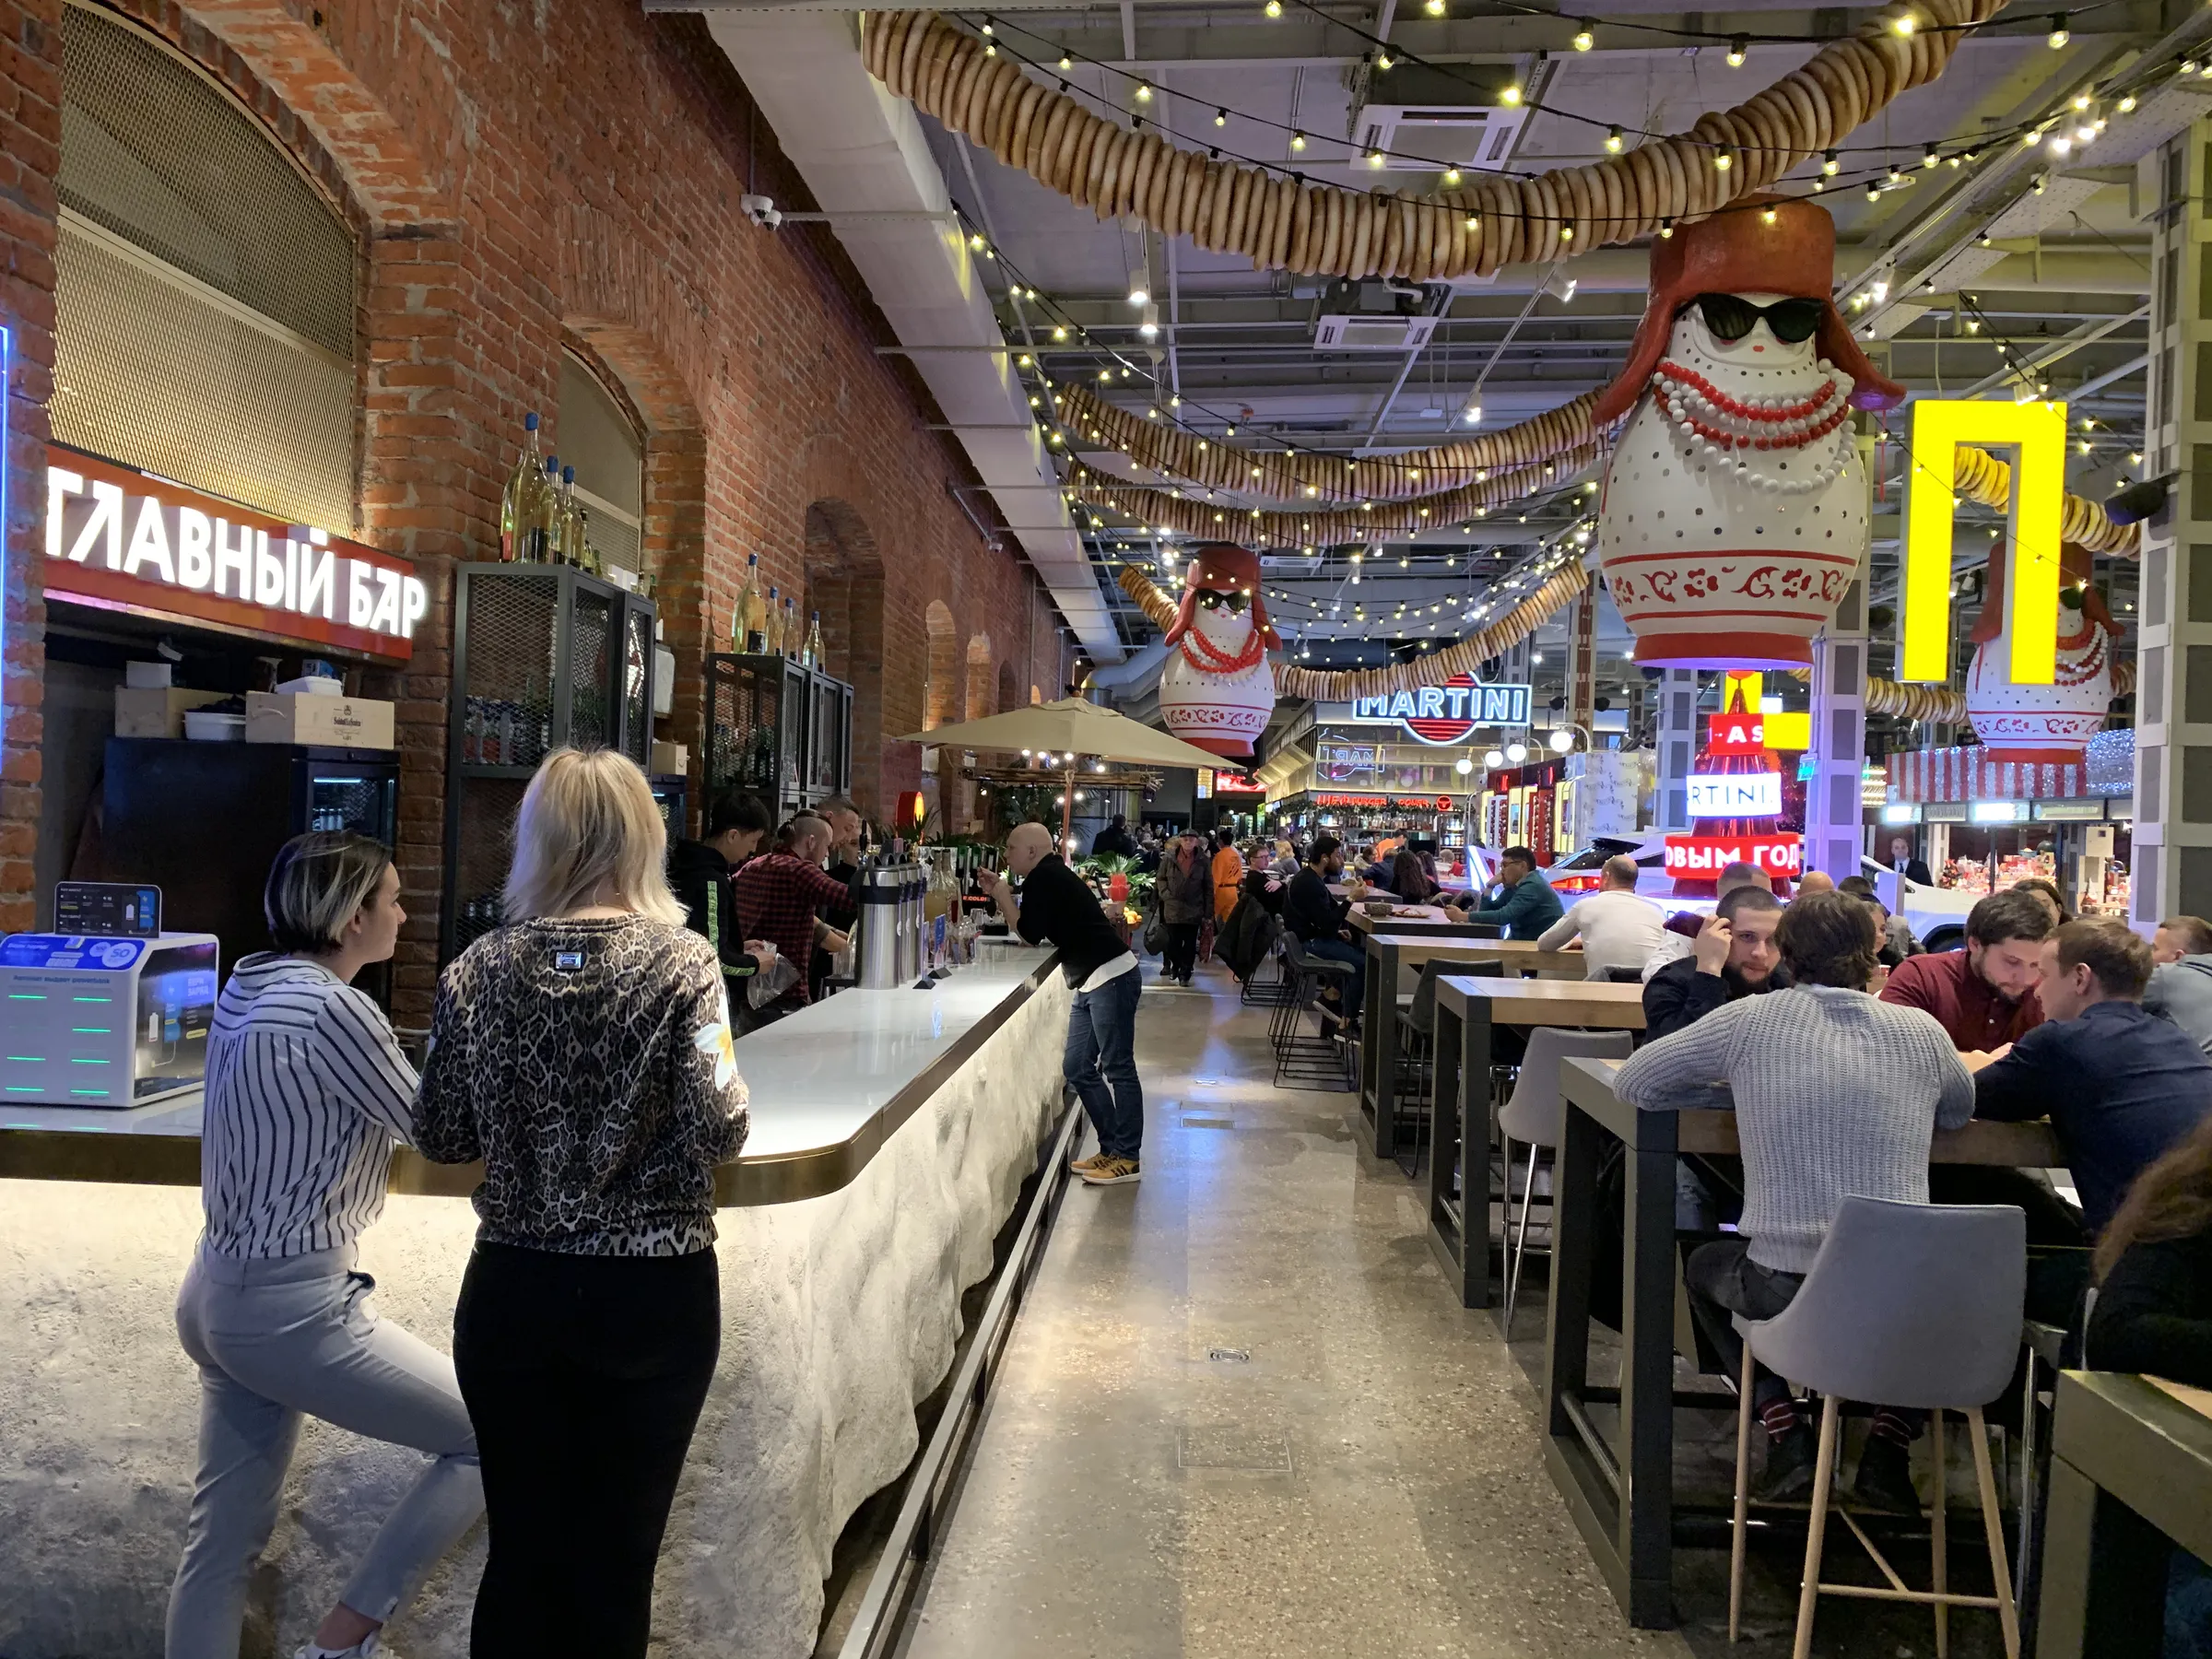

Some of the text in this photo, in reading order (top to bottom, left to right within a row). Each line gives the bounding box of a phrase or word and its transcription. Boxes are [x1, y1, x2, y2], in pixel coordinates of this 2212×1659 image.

[45, 465, 427, 639] ГЛАВНЫЙ БАР
[1360, 687, 1524, 721] MARTINI
[1687, 785, 1765, 805] RTINI
